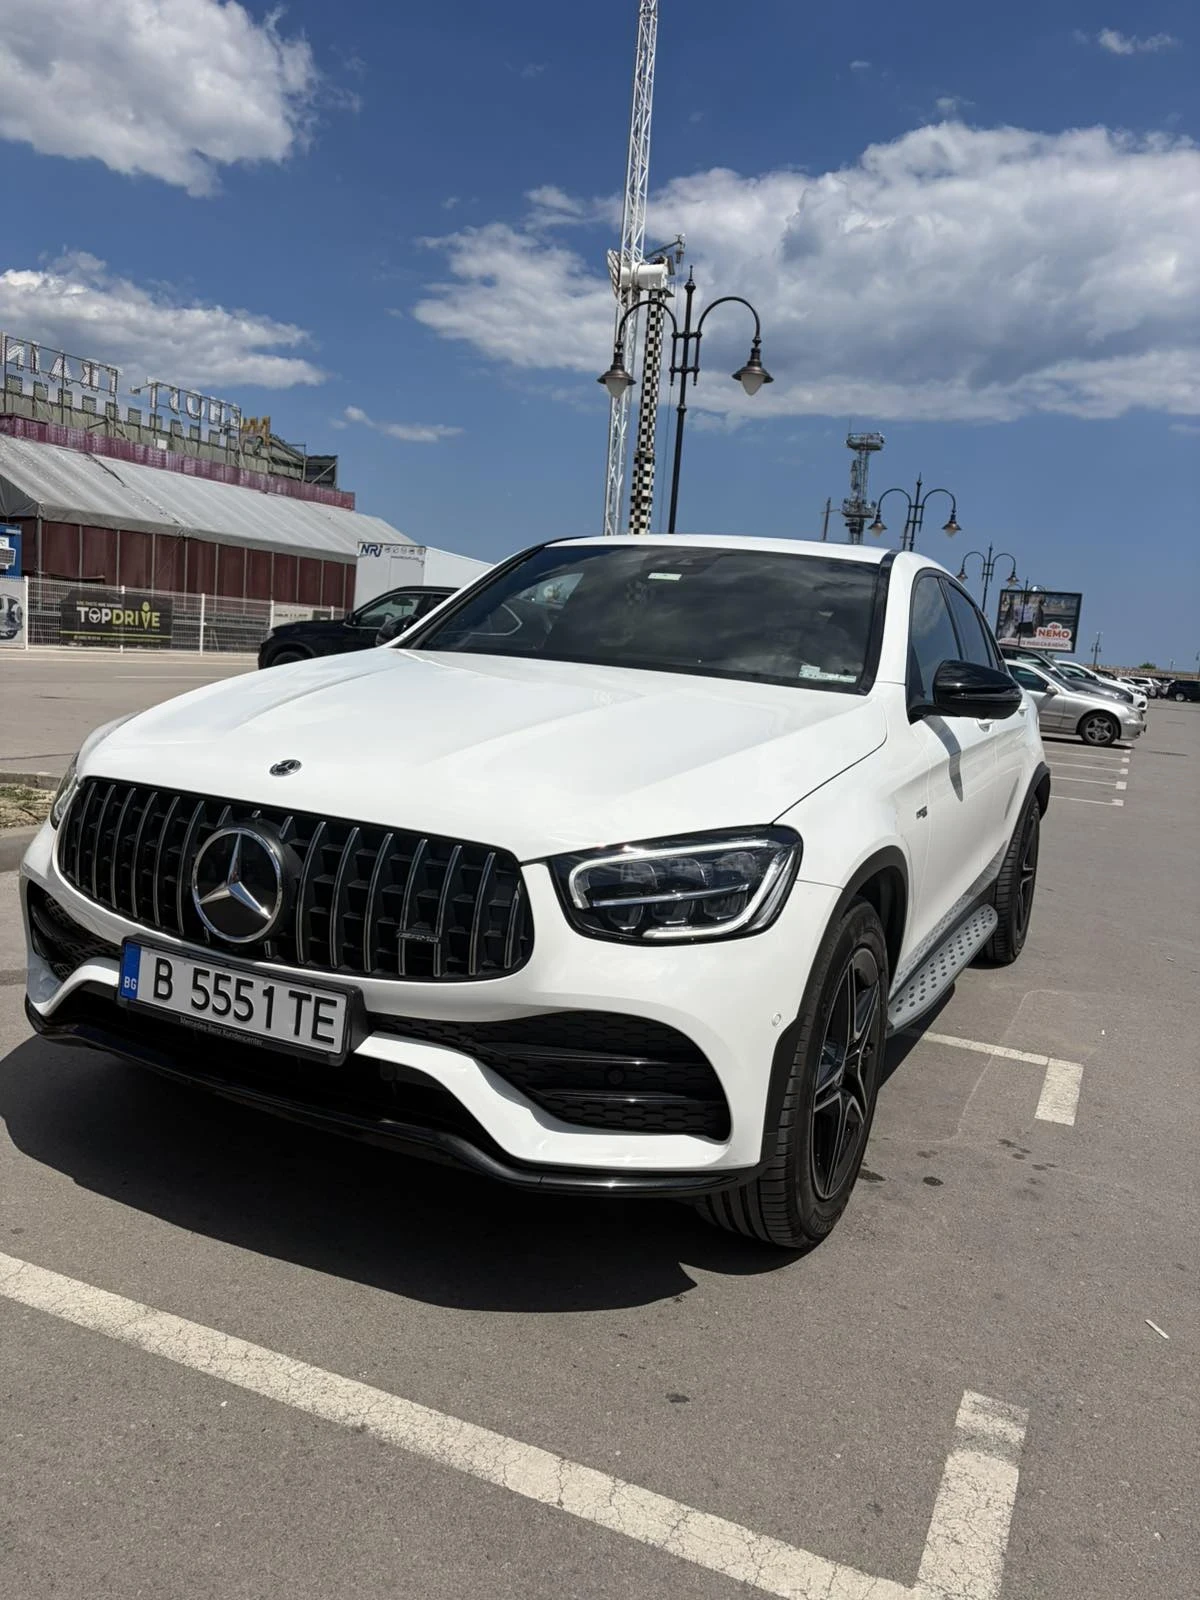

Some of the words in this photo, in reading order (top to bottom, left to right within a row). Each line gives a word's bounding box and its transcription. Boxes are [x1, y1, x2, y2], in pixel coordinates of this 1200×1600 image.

[76, 605, 161, 630] TOPDRIVE
[1039, 629, 1069, 638] NEMO
[124, 975, 137, 991] BG
[153, 957, 173, 1001] B
[191, 967, 275, 1029] 5551
[288, 989, 338, 1044] TE
